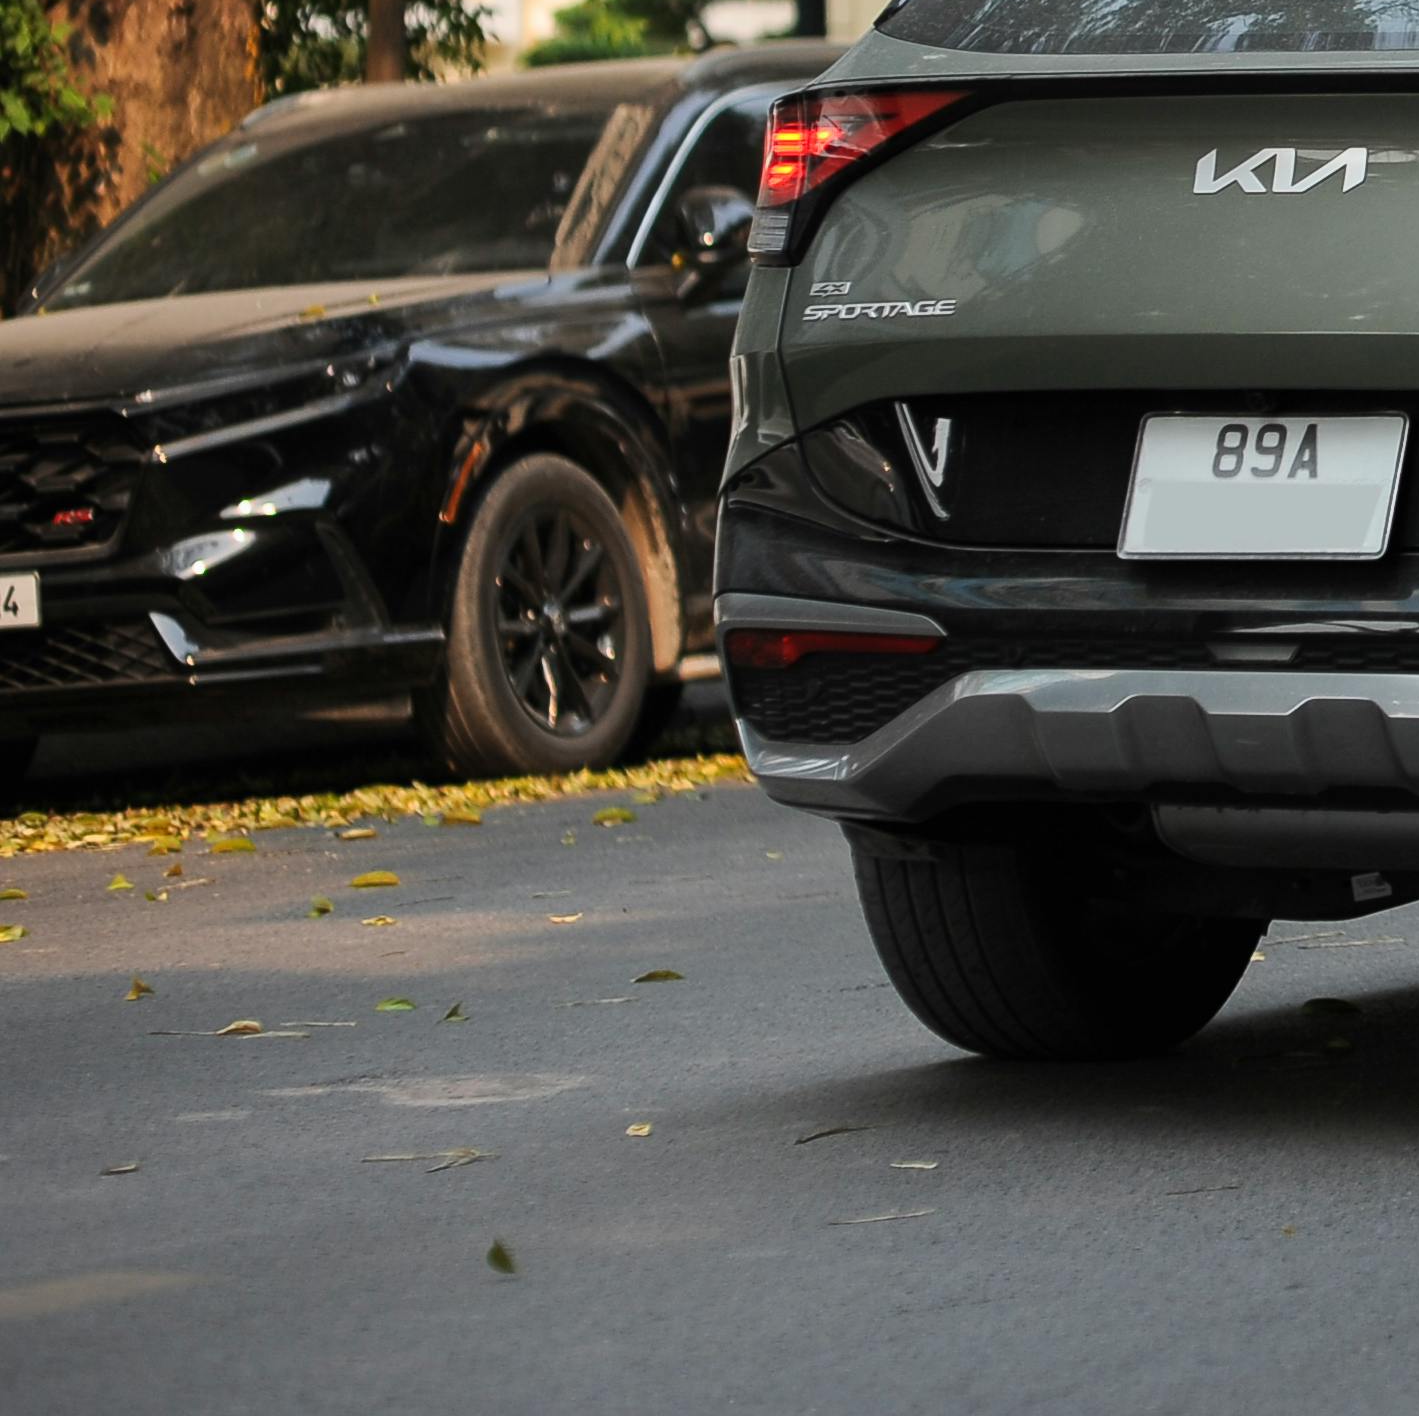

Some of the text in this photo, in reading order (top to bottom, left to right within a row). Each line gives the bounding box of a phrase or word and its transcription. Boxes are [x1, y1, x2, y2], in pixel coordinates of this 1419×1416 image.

[1193, 147, 1368, 195] KIA
[802, 299, 958, 321] SPORTAGE
[1212, 423, 1319, 479] 89A
